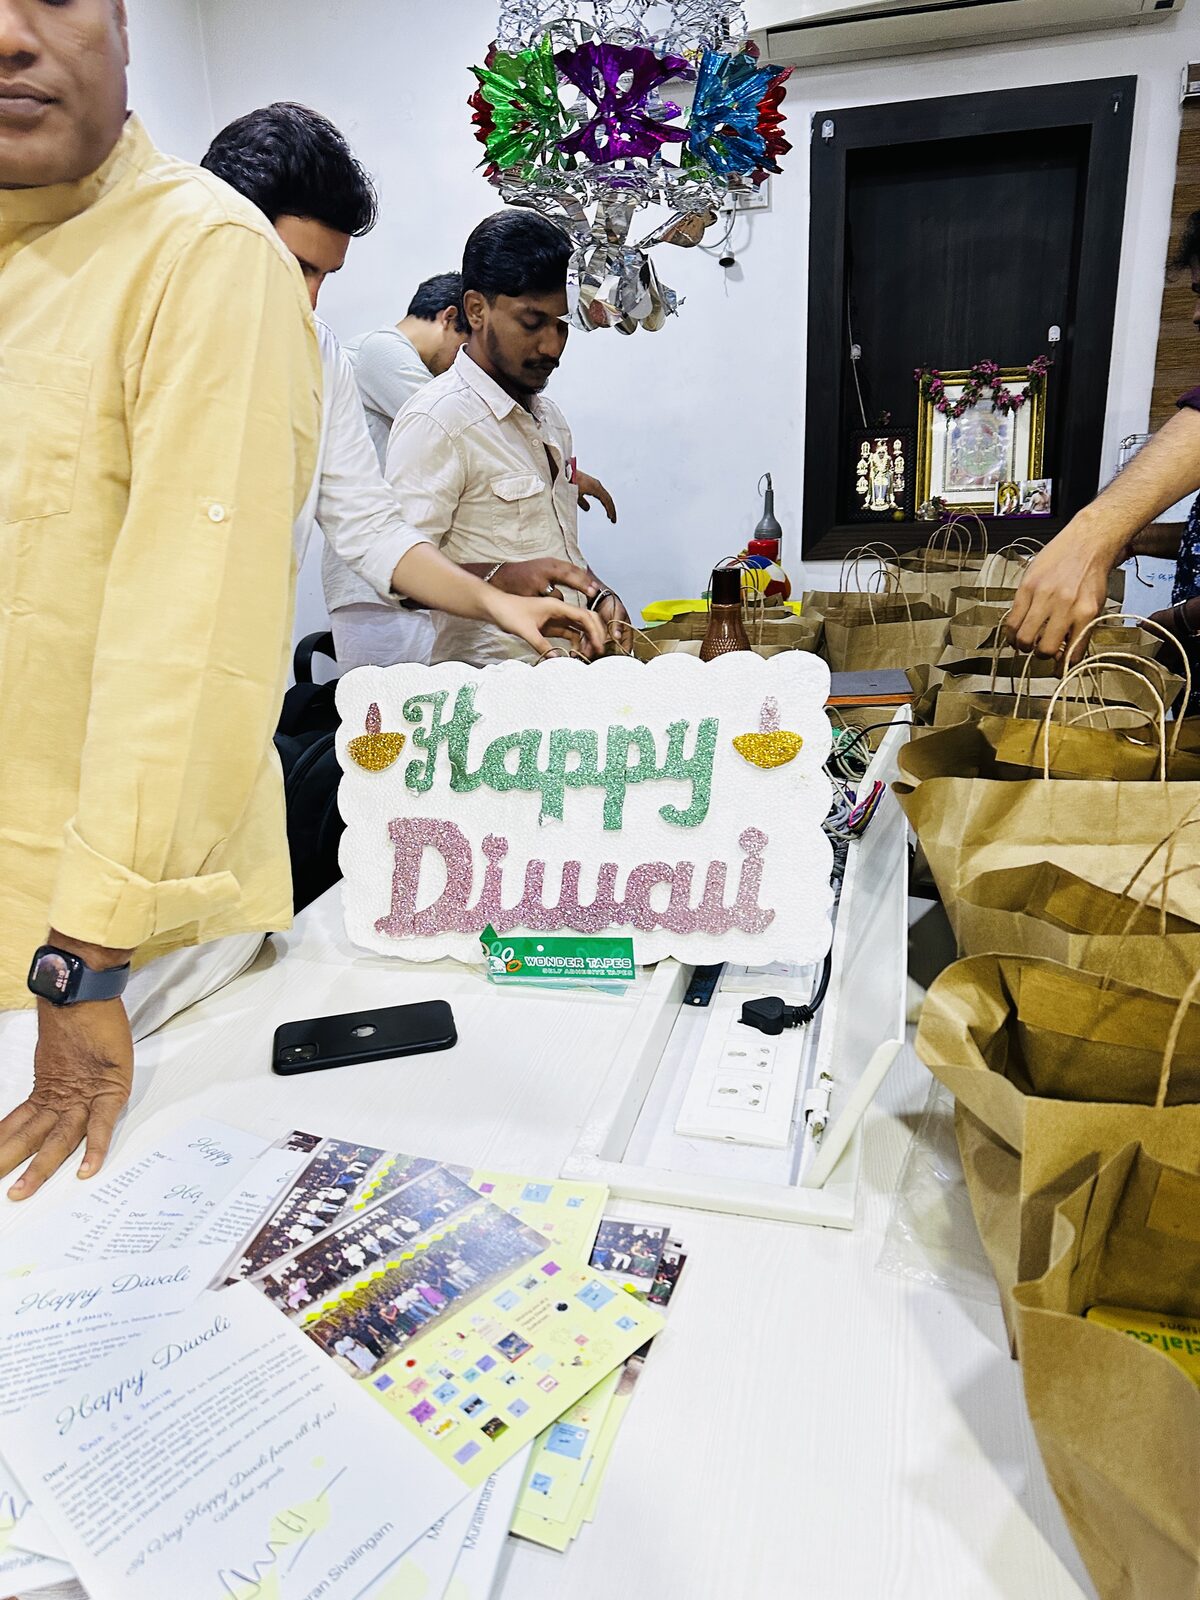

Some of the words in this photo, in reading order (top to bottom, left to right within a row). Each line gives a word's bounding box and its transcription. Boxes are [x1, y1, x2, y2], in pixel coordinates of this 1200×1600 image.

[402, 681, 719, 830] Happy
[524, 956, 584, 968] WONDER
[587, 957, 632, 969] TAPES
[15, 1287, 102, 1315] Happy
[112, 1265, 191, 1294] Diwali
[56, 1369, 148, 1436] Happy
[152, 1315, 231, 1370] Diwali
[328, 1520, 395, 1583] Sivalingam
